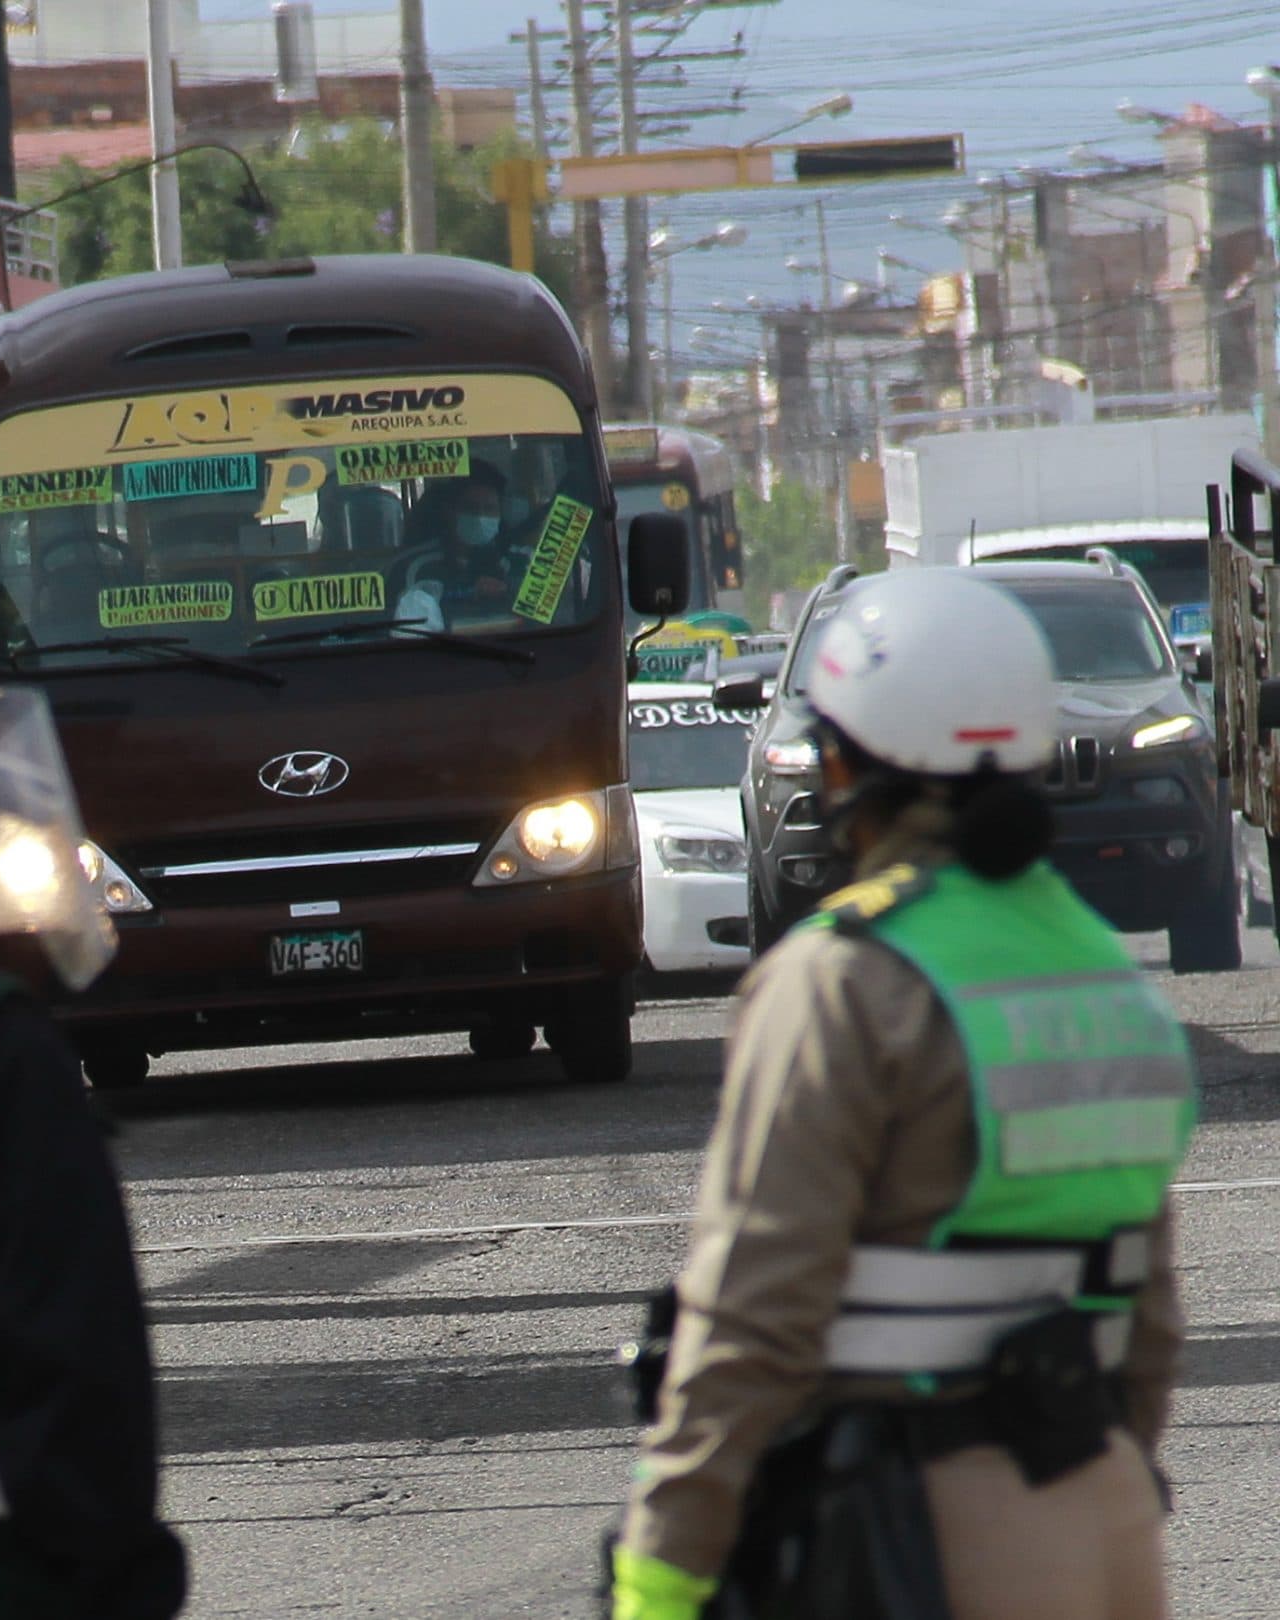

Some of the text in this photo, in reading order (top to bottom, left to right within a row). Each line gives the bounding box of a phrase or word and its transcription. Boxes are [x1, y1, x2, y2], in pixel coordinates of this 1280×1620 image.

[290, 386, 465, 420] MASIVO
[351, 413, 468, 432] AREQUIPA S.A.C.
[289, 575, 381, 613] CATOLICA
